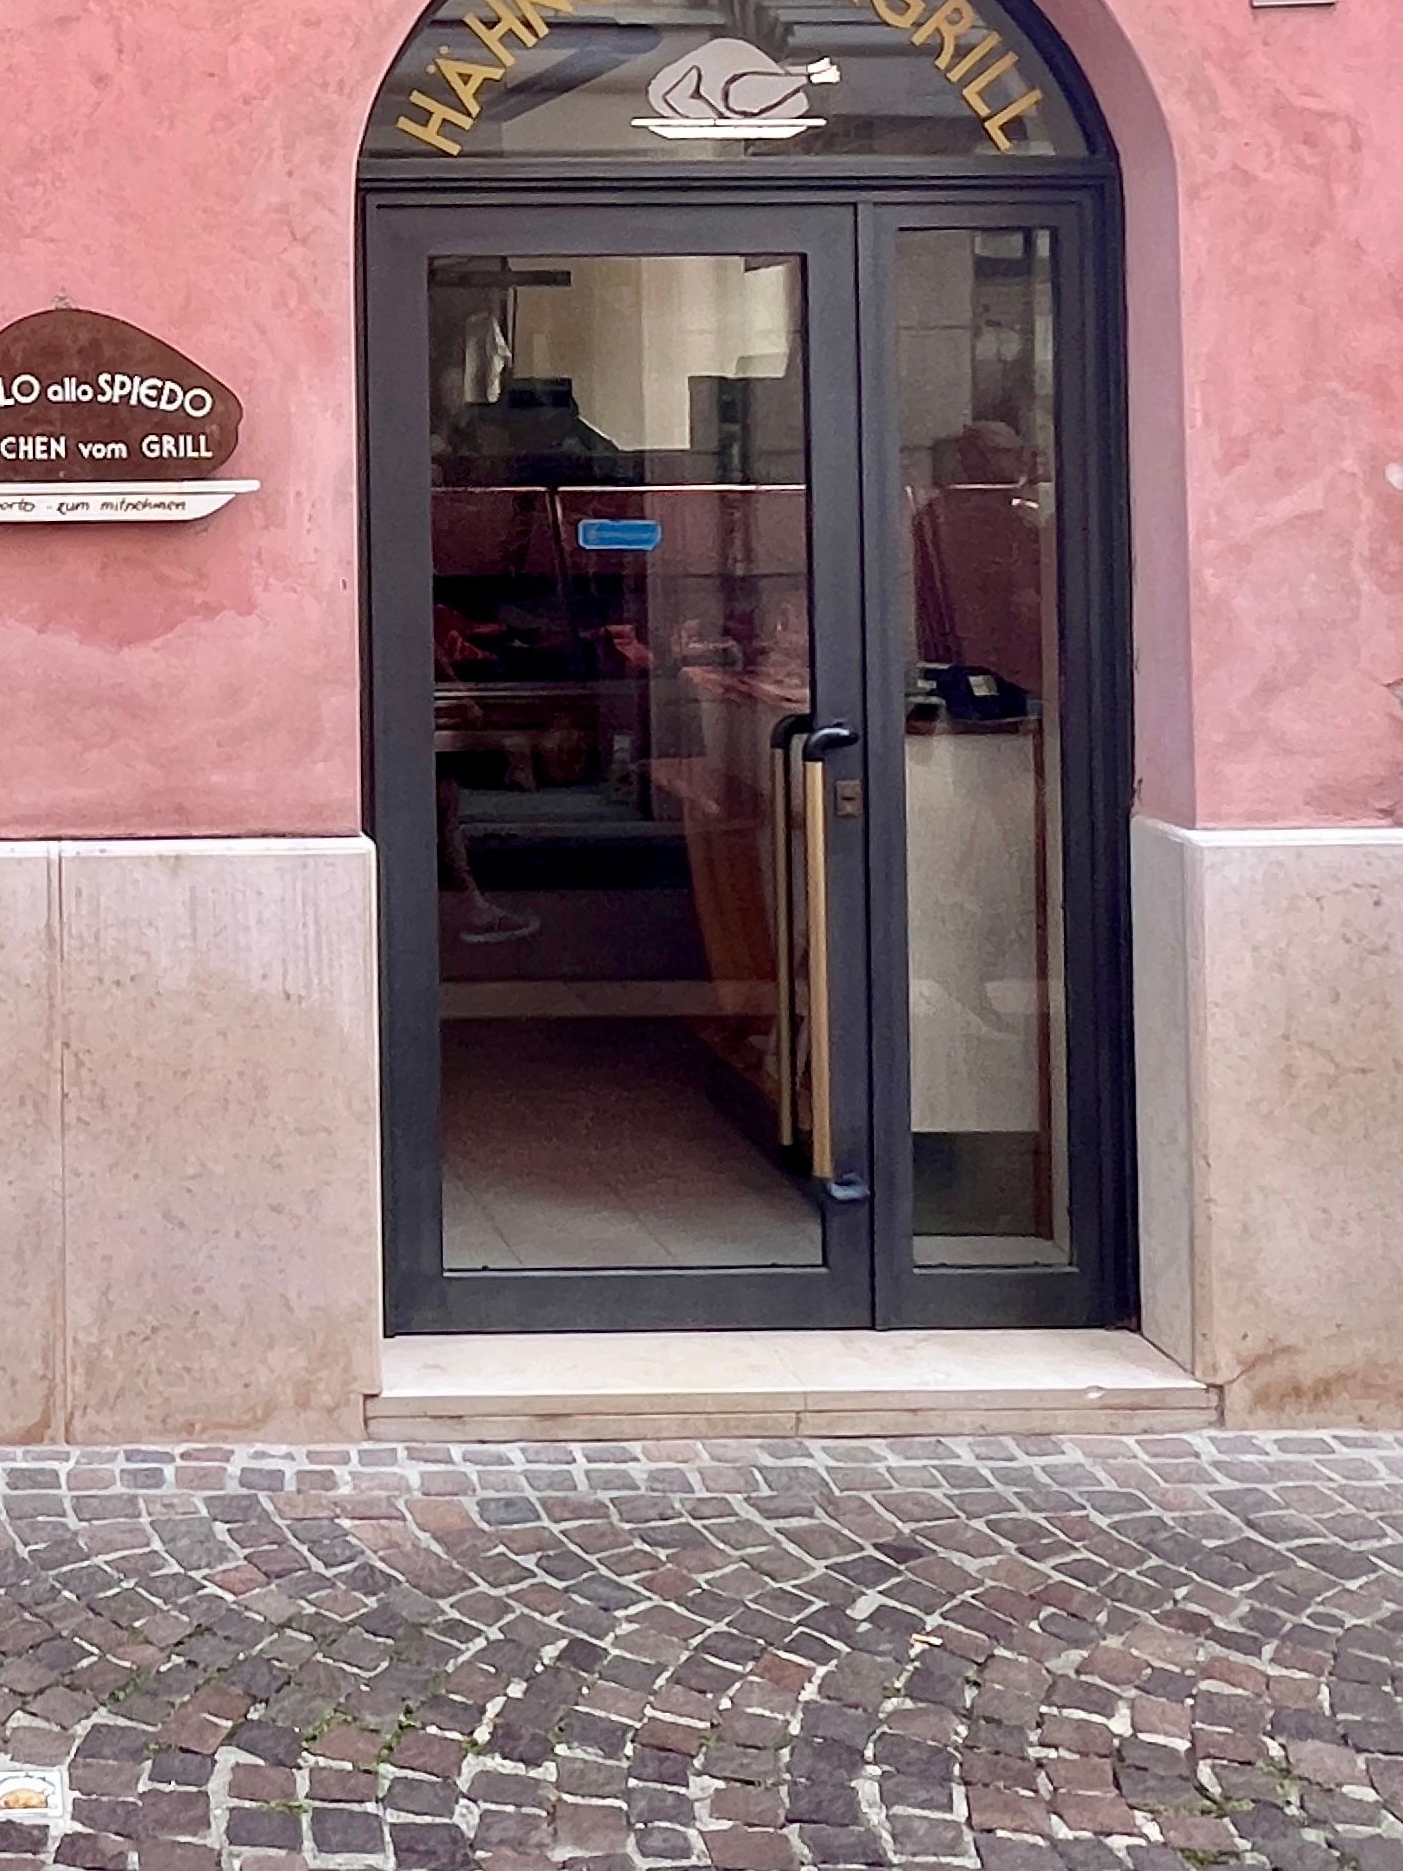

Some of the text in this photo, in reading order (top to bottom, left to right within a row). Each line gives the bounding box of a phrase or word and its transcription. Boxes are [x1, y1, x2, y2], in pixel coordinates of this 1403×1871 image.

[46, 377, 95, 403] allo
[96, 372, 214, 418] SPIEDO
[77, 442, 128, 459] vom
[140, 434, 214, 459] GRILL
[56, 500, 91, 515] zum
